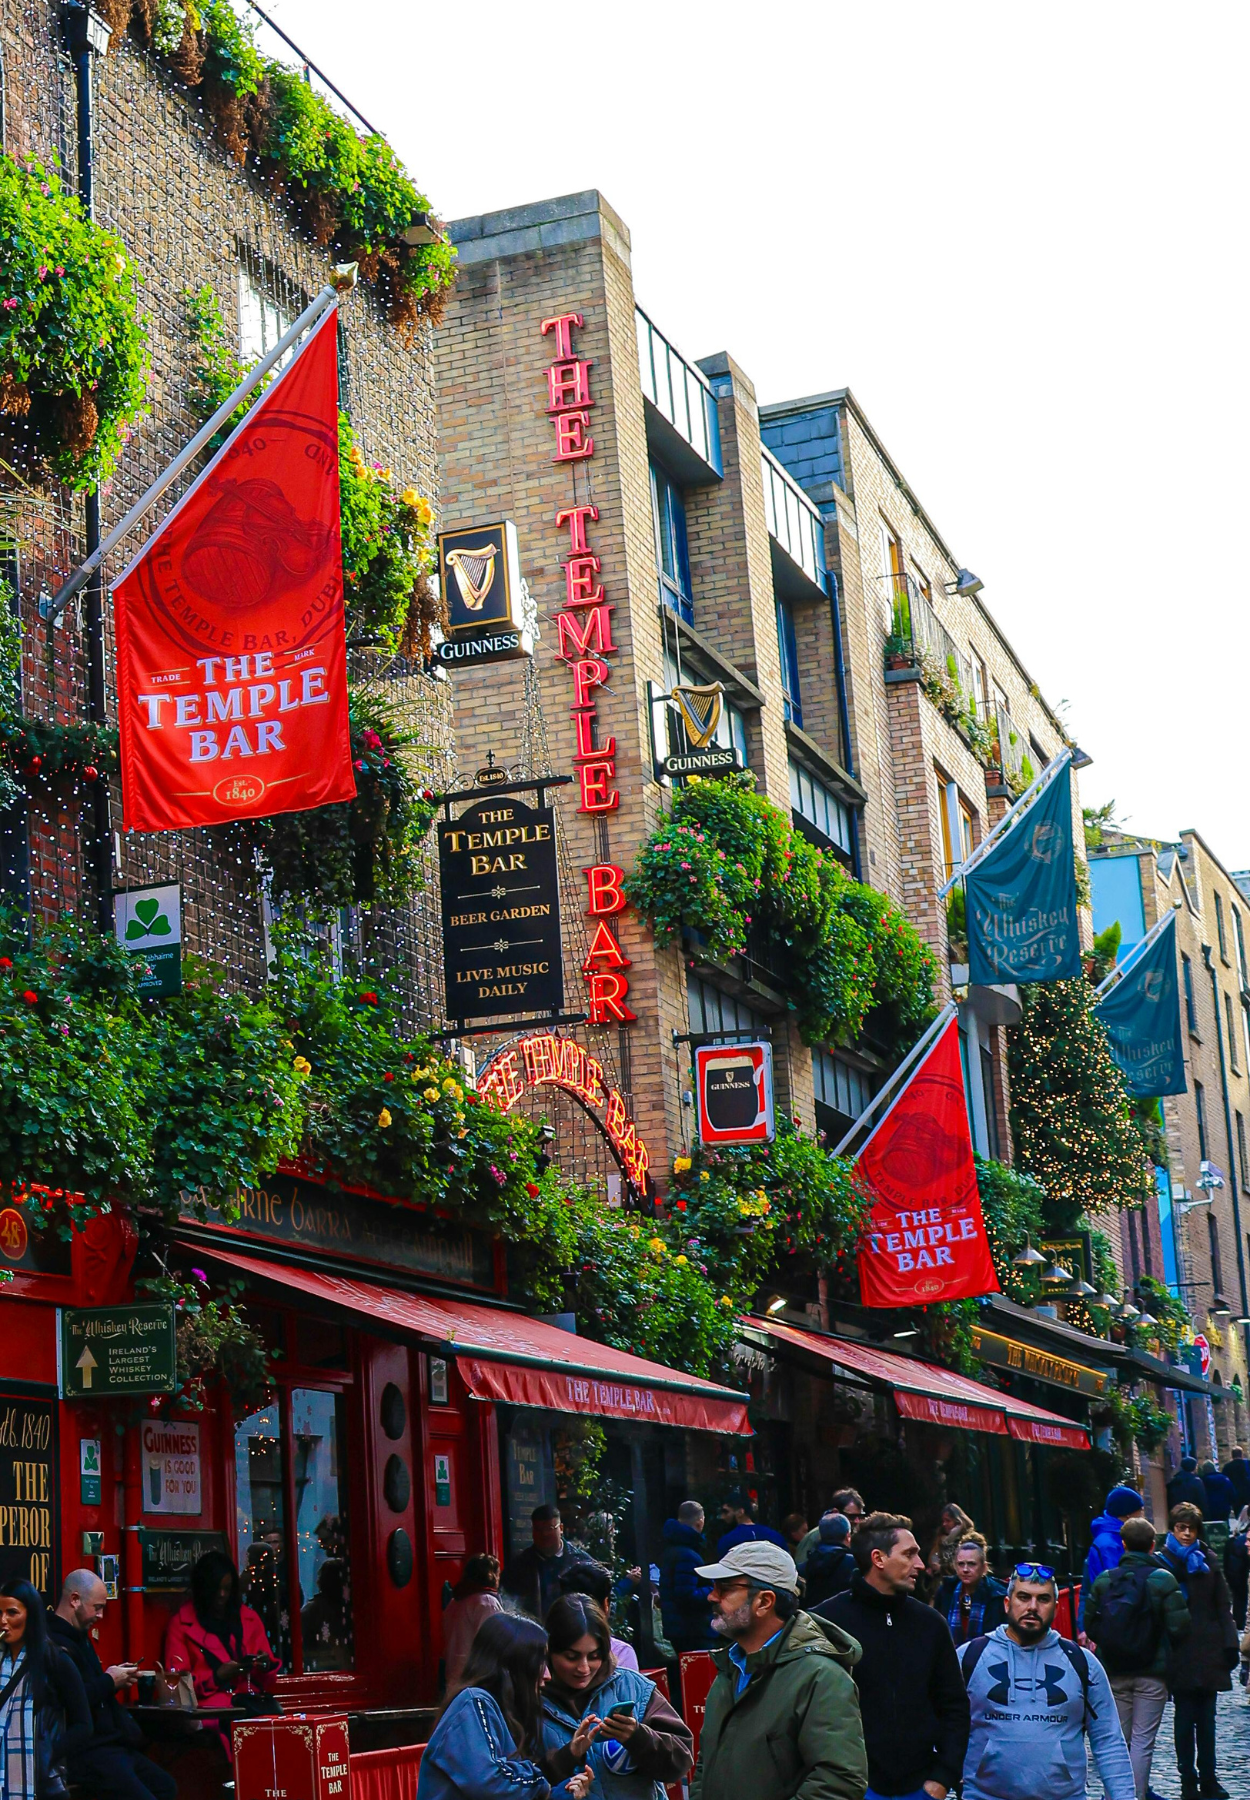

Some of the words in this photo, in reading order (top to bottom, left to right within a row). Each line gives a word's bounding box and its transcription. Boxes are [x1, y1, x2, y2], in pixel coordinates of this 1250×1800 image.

[540, 313, 595, 462] THE
[163, 579, 234, 648] TEMPLE
[440, 634, 520, 660] GUINNESS
[150, 673, 181, 684] TRADE
[294, 649, 315, 661] MARK
[197, 651, 276, 686] THE
[553, 504, 619, 814] TEMPLE
[138, 667, 330, 730] TEMPLE
[188, 720, 287, 763] BAR
[666, 752, 733, 771] GUINNESS
[225, 787, 255, 800] 1840
[478, 808, 514, 824] THE
[444, 824, 550, 854] TEMPLE
[470, 852, 528, 876] BAR
[450, 913, 487, 927] BEER
[490, 904, 550, 921] GARDEN
[583, 864, 637, 1024] BAR
[456, 968, 493, 983] LIVE
[496, 961, 549, 977] MUSIC
[478, 982, 527, 999] DAILY
[711, 1081, 751, 1090] GUINNESS
[519, 1034, 603, 1108] TEMPLE
[607, 1089, 649, 1196] BAR
[896, 1208, 942, 1228] THE
[1, 1218, 20, 1248] 48
[865, 1218, 978, 1254] TEMPLE
[896, 1246, 955, 1272] BAR
[70, 1324, 83, 1336] The
[82, 1319, 128, 1339] Whiskey
[128, 1317, 168, 1337] Reserve
[109, 1346, 157, 1355] IRELAND'S
[109, 1356, 150, 1365] LARGEST
[109, 1366, 152, 1374] WHISKEY
[109, 1374, 168, 1383] COLLECTION
[566, 1376, 589, 1402] THE
[591, 1380, 633, 1409] TEMPLE
[634, 1390, 655, 1413] BAR
[21, 1413, 50, 1450] 1840
[144, 1427, 198, 1455] GUINNESS
[164, 1460, 172, 1473] IS
[173, 1461, 196, 1474] GOOD
[519, 1463, 535, 1485] BAR
[13, 1461, 49, 1502] THE
[166, 1479, 180, 1493] FOR
[182, 1480, 196, 1494] YOU
[30, 1552, 50, 1592] OF
[984, 1713, 1021, 1721] UNDER
[1023, 1713, 1069, 1723] ARMOUR
[327, 1752, 340, 1762] THE
[321, 1764, 348, 1780] TEMPLE
[264, 1789, 287, 1798] THE
[328, 1780, 343, 1795] BAR
